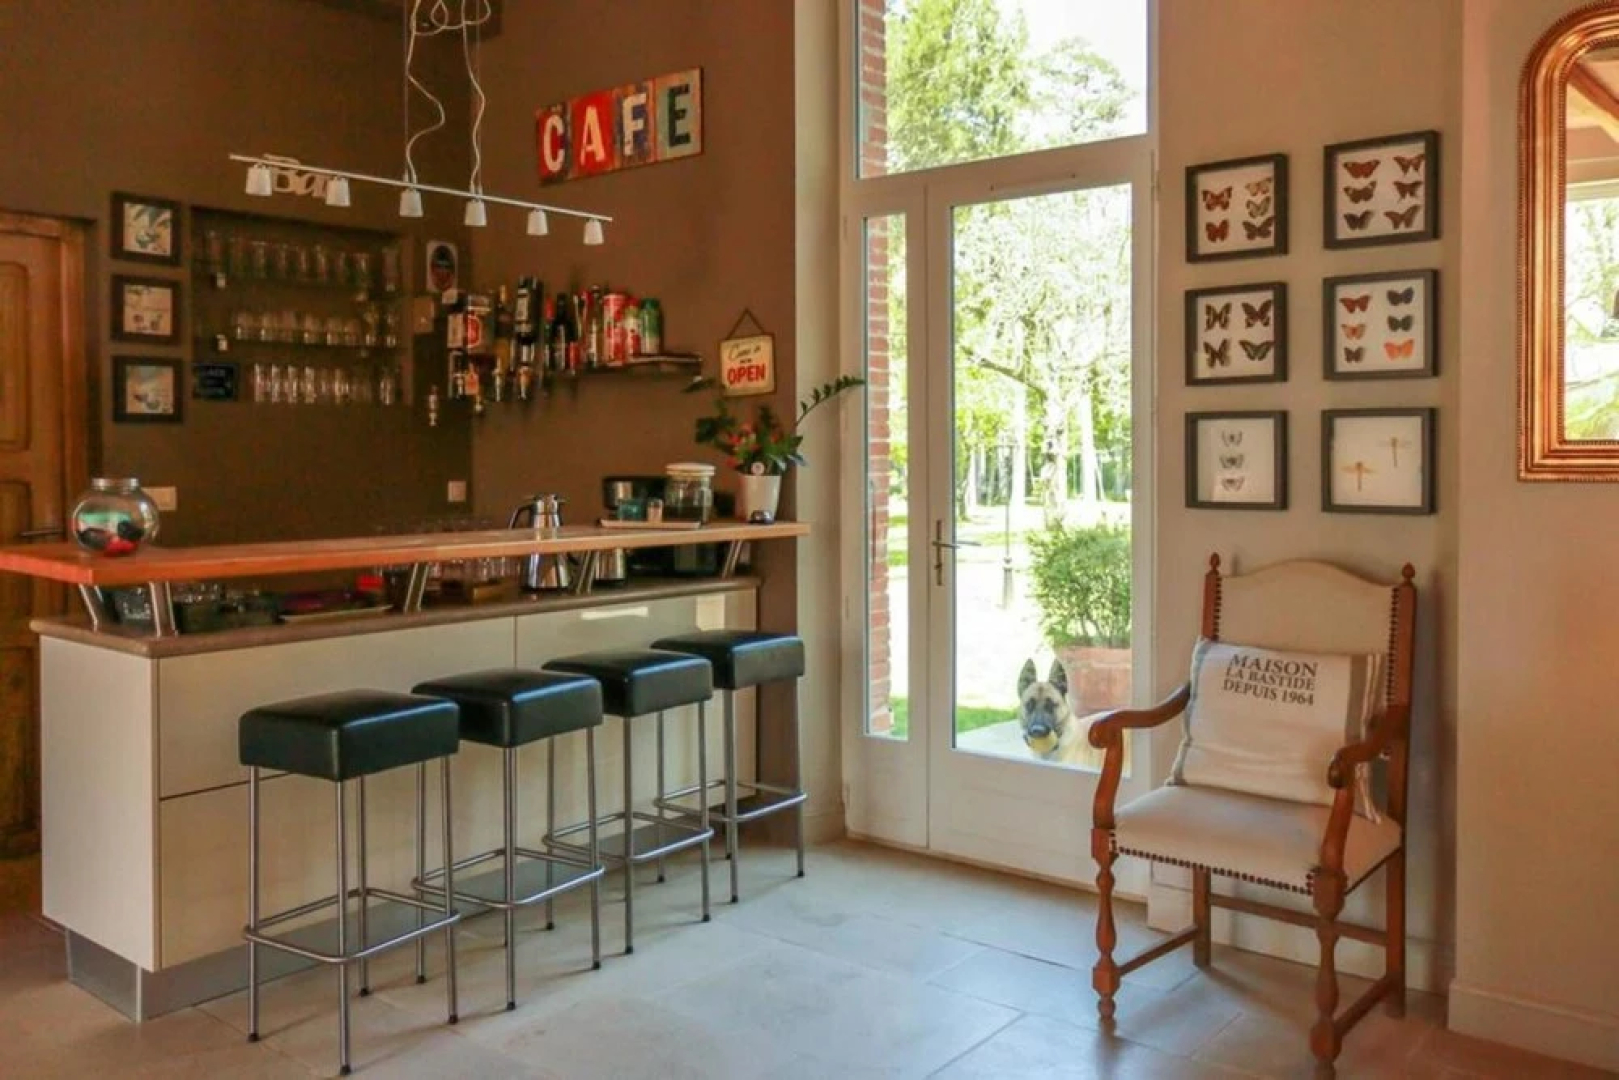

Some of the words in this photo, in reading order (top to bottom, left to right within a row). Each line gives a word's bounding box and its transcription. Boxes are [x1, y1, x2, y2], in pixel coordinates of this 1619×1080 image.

[543, 83, 691, 173] CAFE
[264, 153, 328, 198] Ba
[727, 364, 765, 385] OPEN
[1229, 653, 1318, 677] MAISON
[1225, 667, 1244, 679] LA
[1248, 671, 1315, 691] BASTIDE
[1223, 679, 1277, 701] DEPUIS
[1281, 690, 1314, 706] 1964
